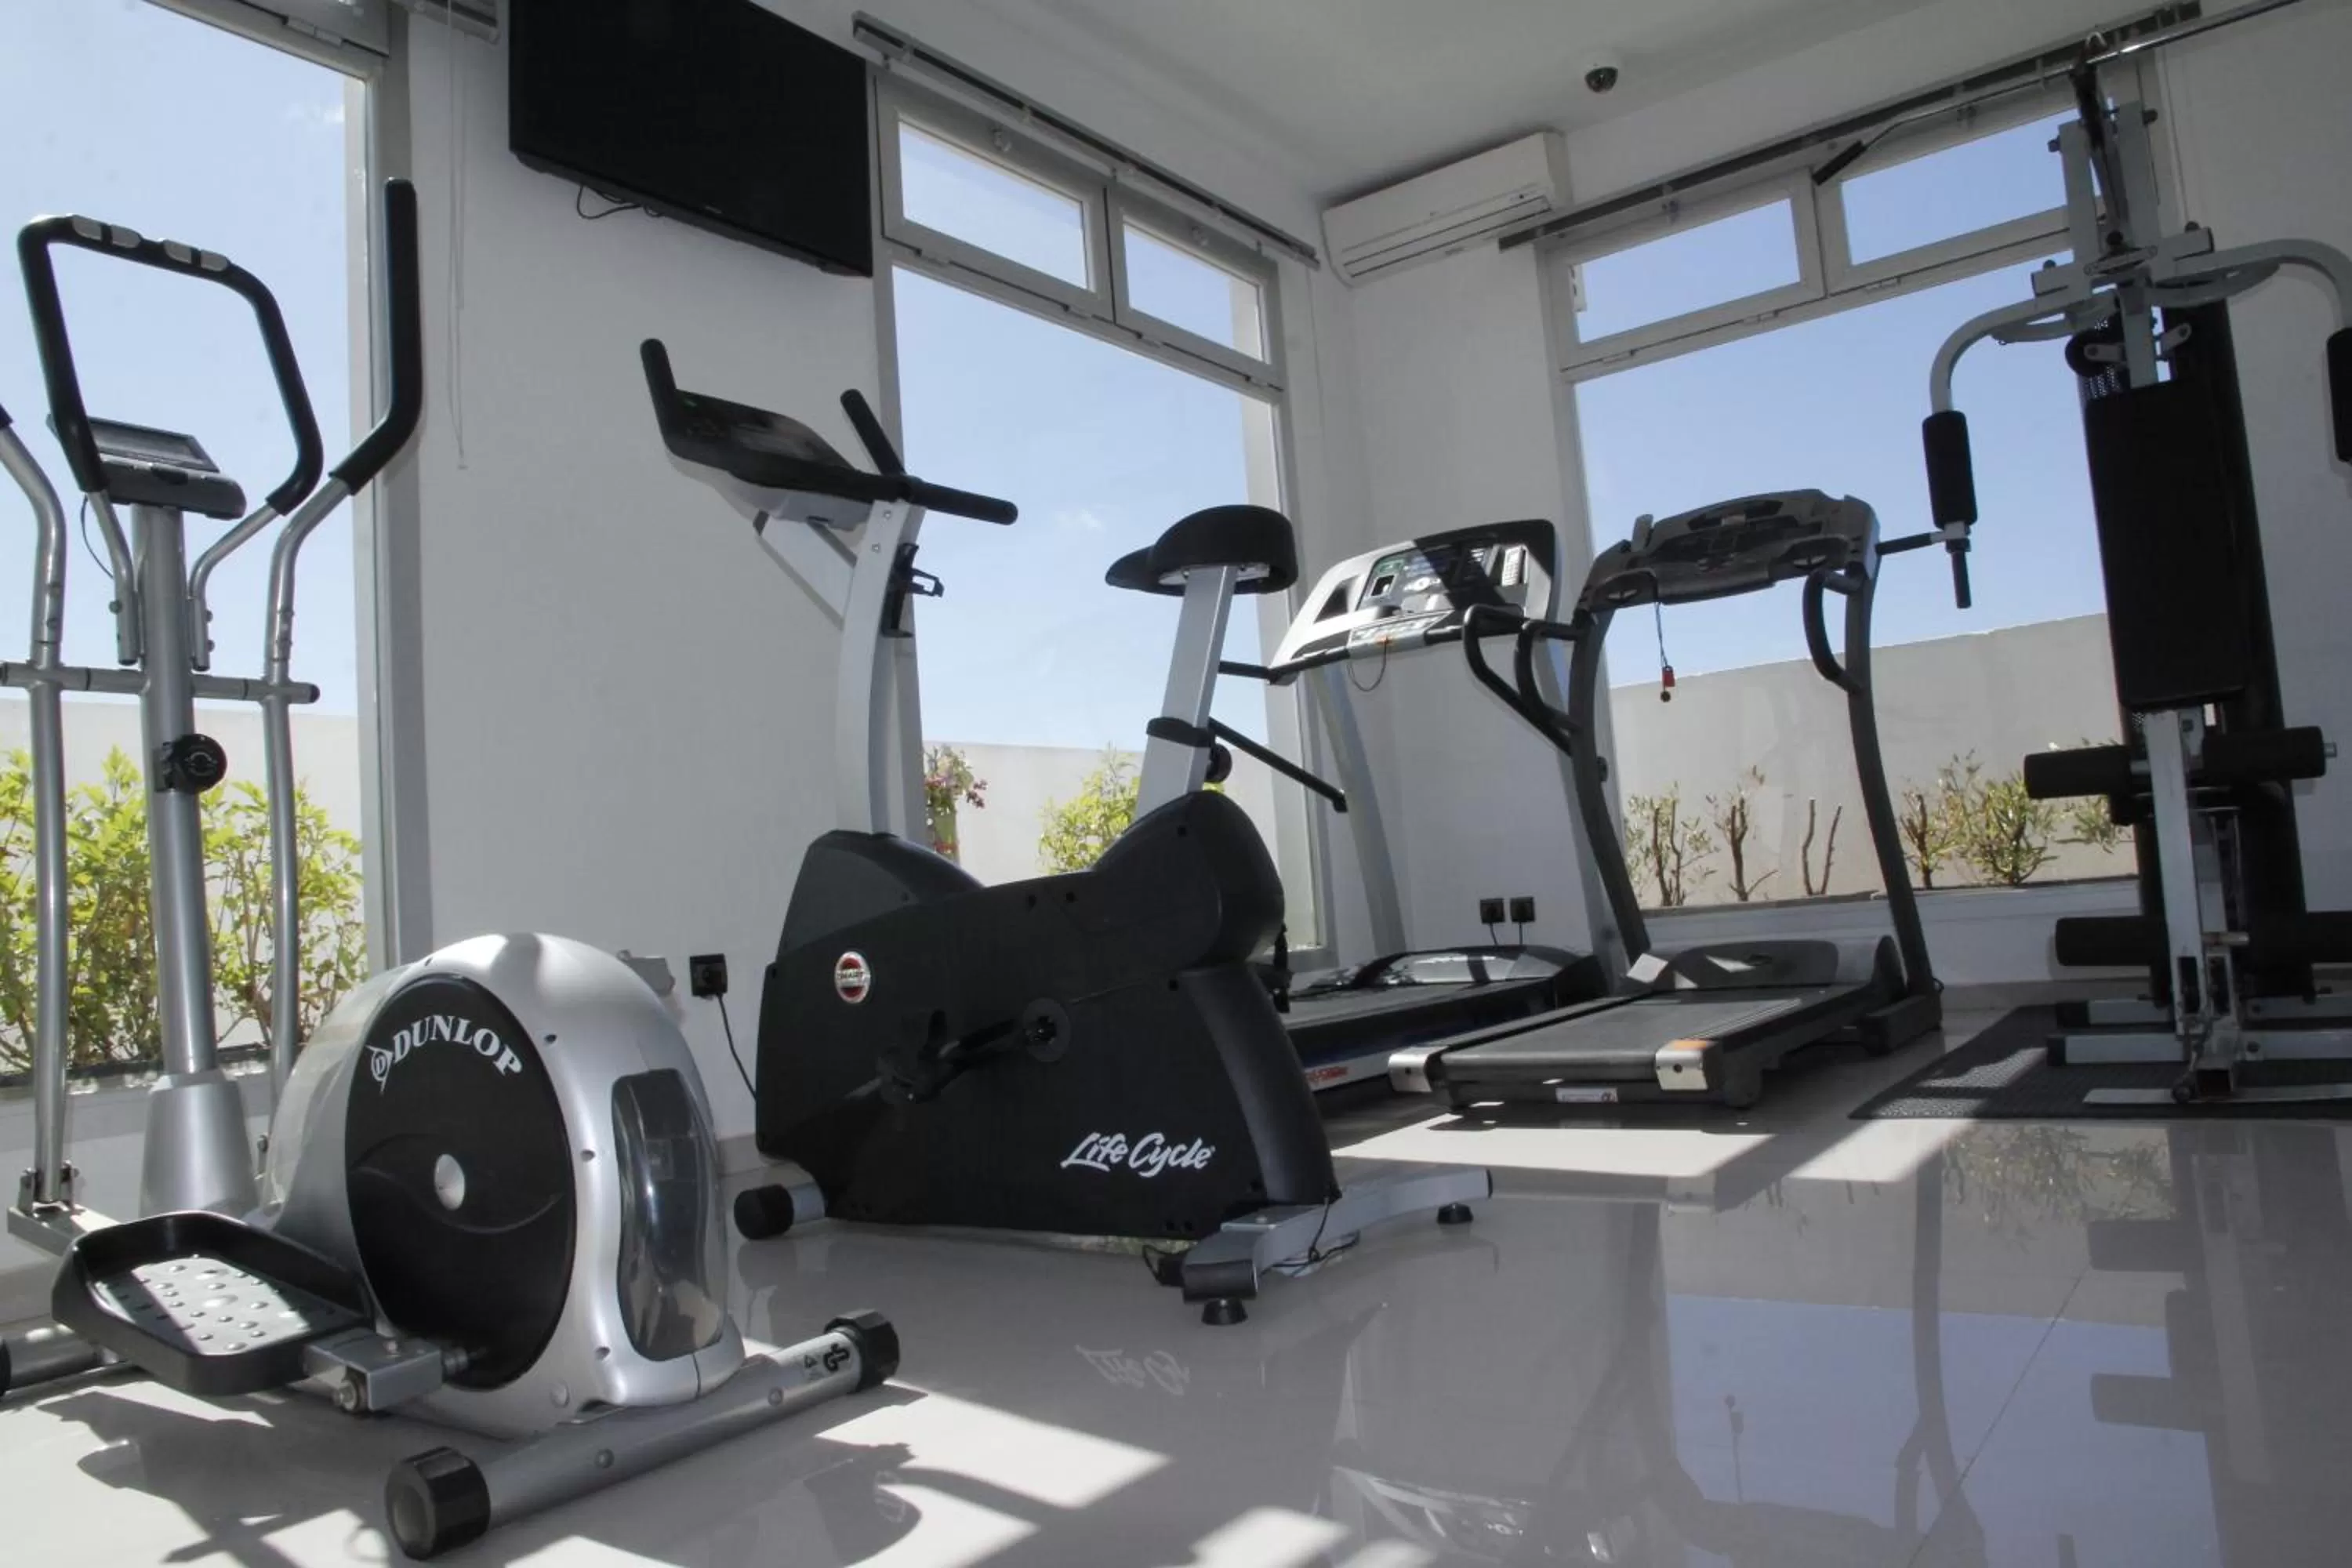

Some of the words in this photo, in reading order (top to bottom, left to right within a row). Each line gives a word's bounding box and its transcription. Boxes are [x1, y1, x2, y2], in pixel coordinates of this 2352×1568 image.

[392, 1014, 523, 1076] DUNLOP
[1060, 1132, 1129, 1171] Life
[1128, 1131, 1212, 1178] Cycle
